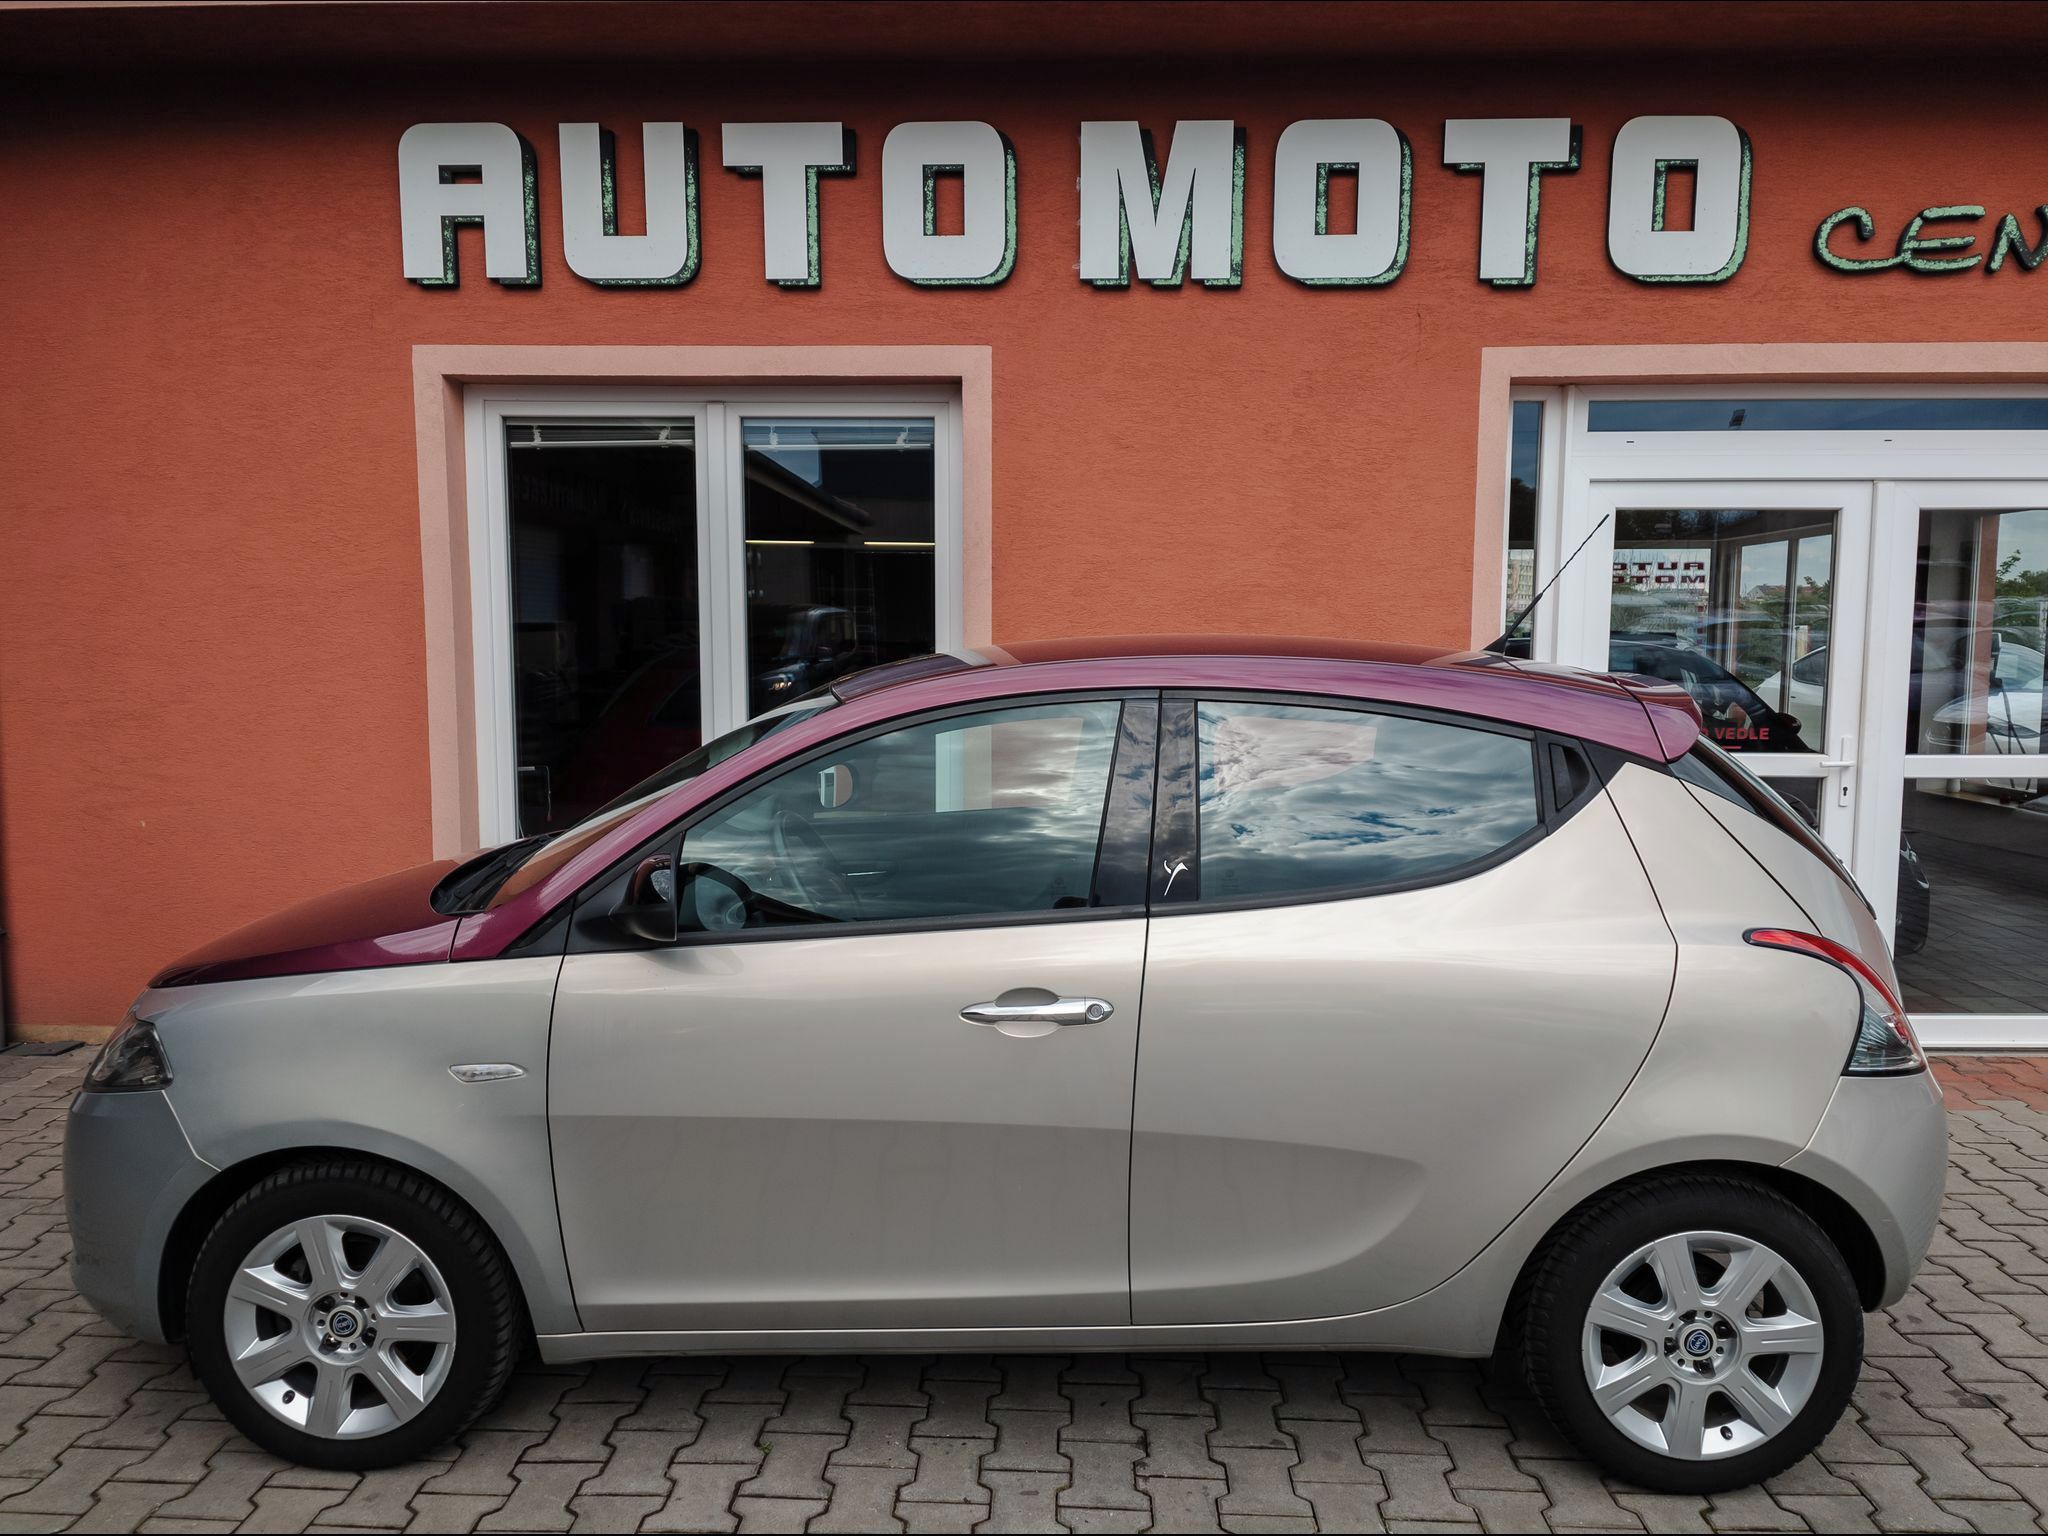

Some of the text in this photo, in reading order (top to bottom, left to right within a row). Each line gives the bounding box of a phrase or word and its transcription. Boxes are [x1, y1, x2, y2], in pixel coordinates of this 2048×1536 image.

[397, 115, 2048, 288] AUTO MOTO CEN
[1714, 727, 1770, 740] VEDLE
